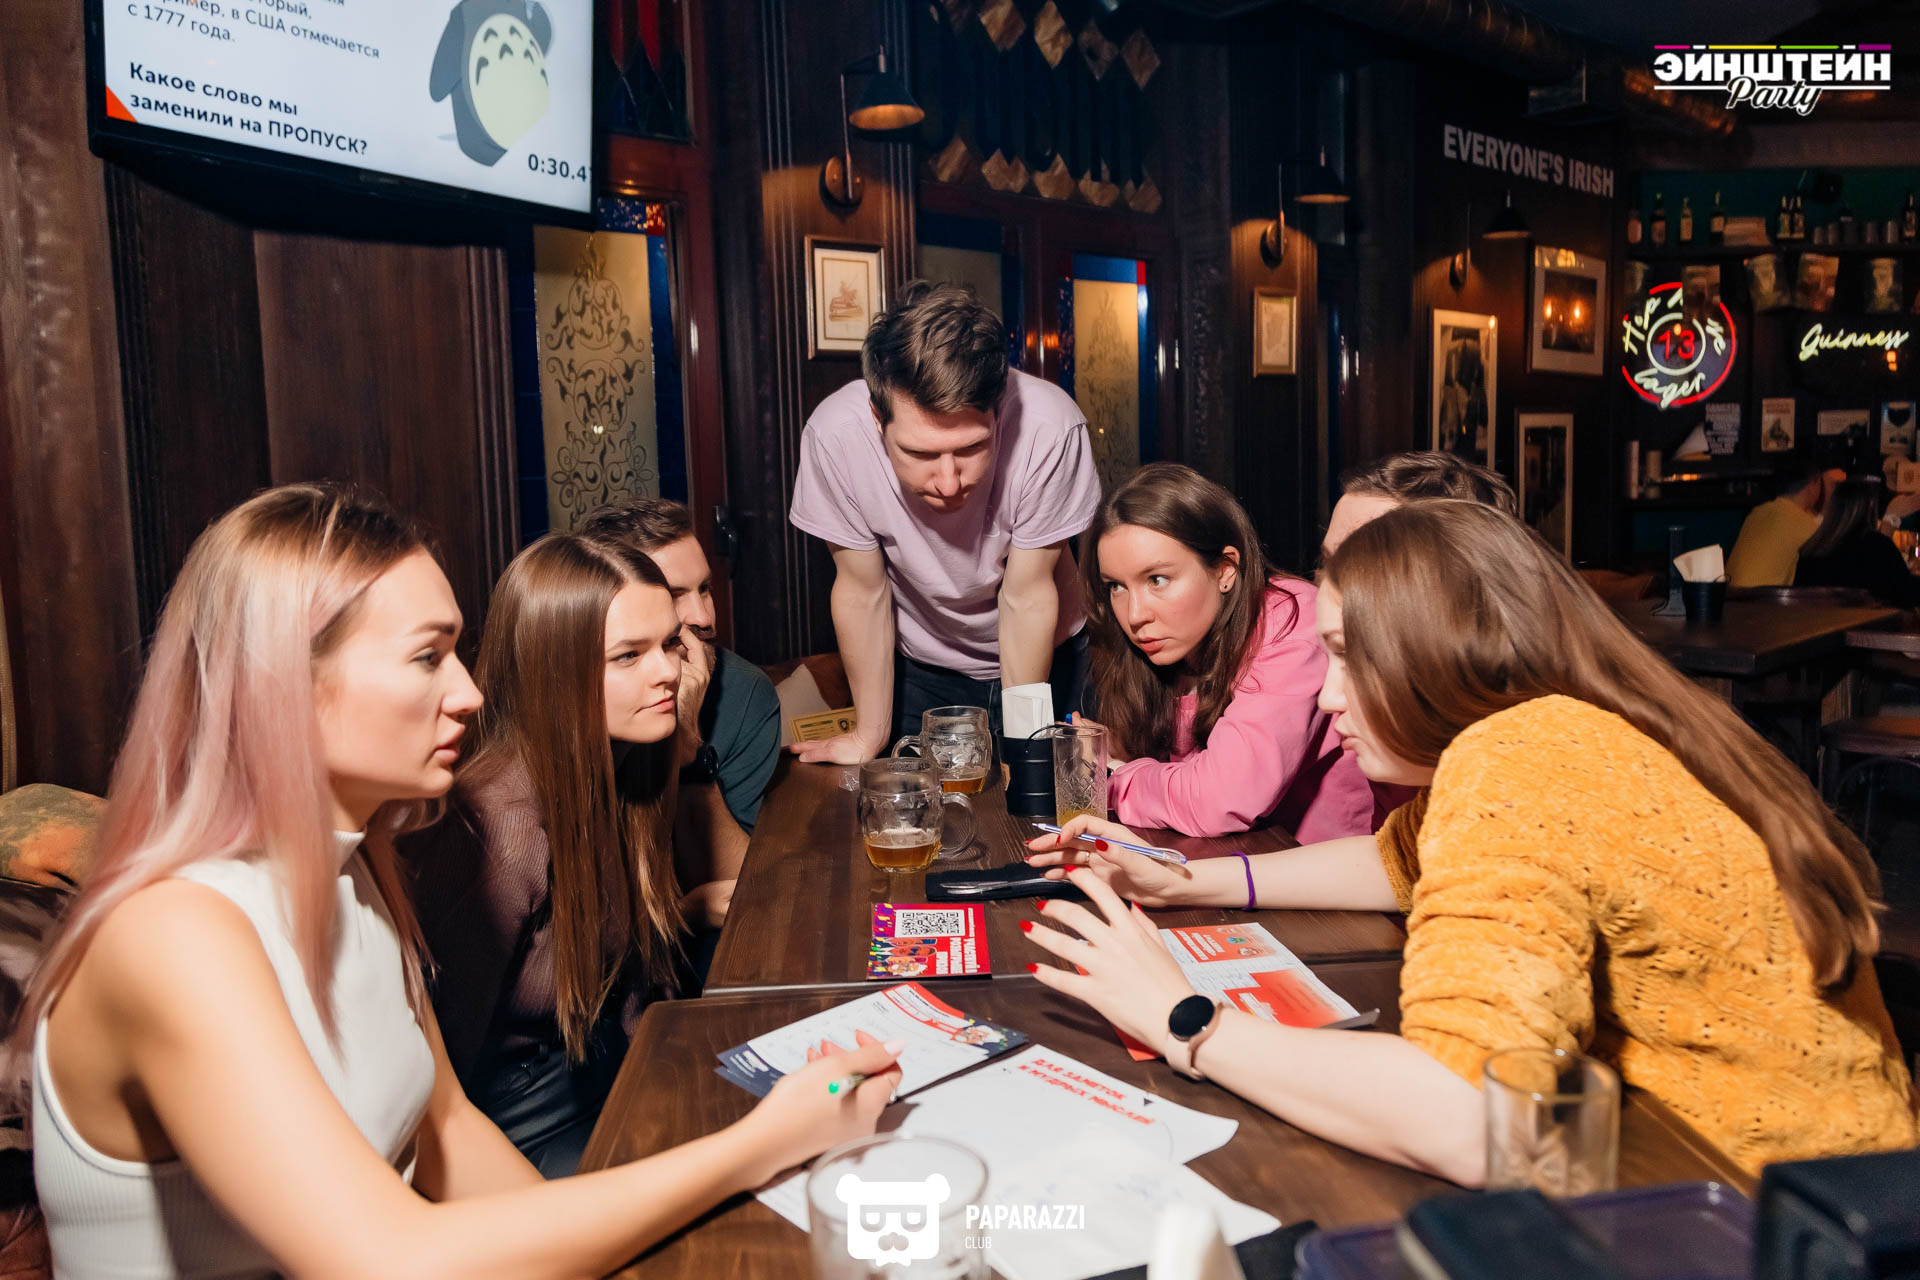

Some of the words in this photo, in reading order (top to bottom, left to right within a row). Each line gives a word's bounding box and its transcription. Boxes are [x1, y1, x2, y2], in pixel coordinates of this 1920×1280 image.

[144, 4, 185, 28] 1777
[191, 20, 236, 43] года.
[231, 8, 240, 20] в
[245, 8, 286, 33] США
[290, 24, 380, 59] отмечается
[130, 62, 196, 93] Какое
[202, 83, 262, 108] слово
[269, 98, 298, 116] мы
[130, 93, 234, 128] заменили
[240, 115, 262, 134] на
[268, 120, 368, 155] ПРОПУСК?
[1444, 124, 1564, 187] EVERYONE'S
[1568, 158, 1614, 199] IRISH
[1658, 329, 1695, 360] 13
[1798, 322, 1910, 362] Guinness
[1633, 366, 1706, 409] Lager
[1028, 1069, 1087, 1097] МУДРЫХ
[1062, 1071, 1127, 1101] ЗАМЕТОК
